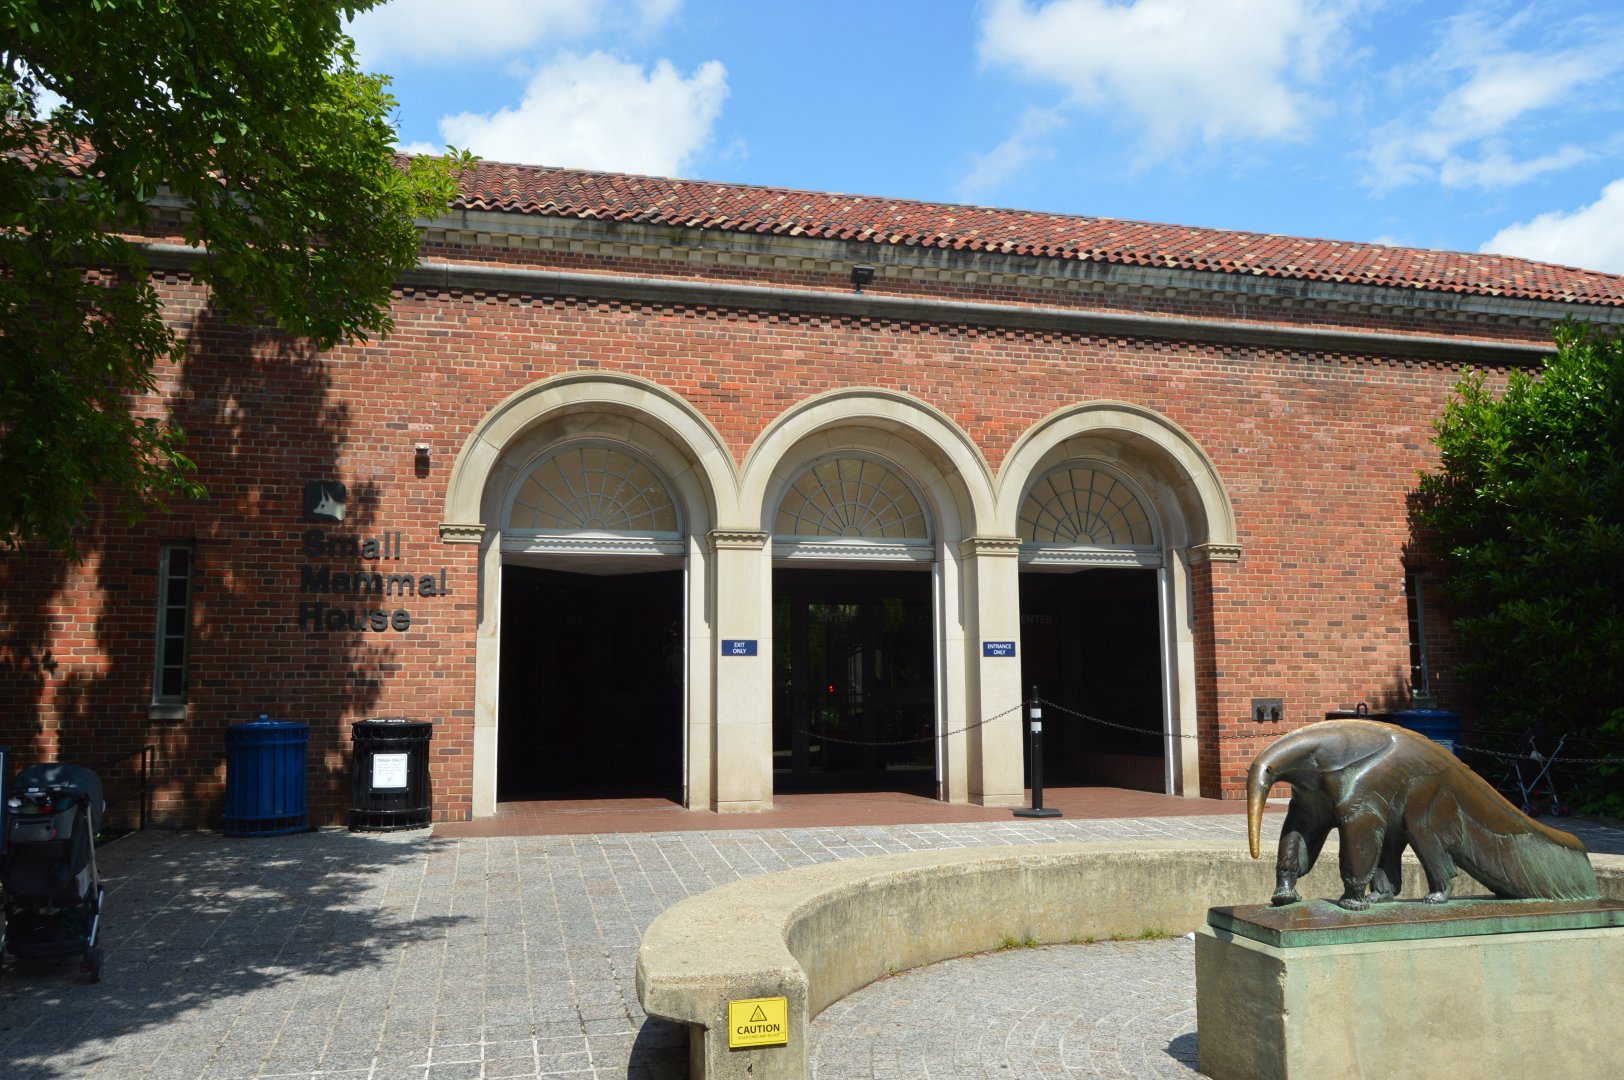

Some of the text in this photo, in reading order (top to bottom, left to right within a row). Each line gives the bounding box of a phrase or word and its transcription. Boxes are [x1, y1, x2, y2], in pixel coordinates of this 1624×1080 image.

[303, 529, 401, 560] Small
[301, 564, 447, 597] Mammal
[300, 601, 411, 632] House
[736, 1023, 780, 1035] CAUTION
